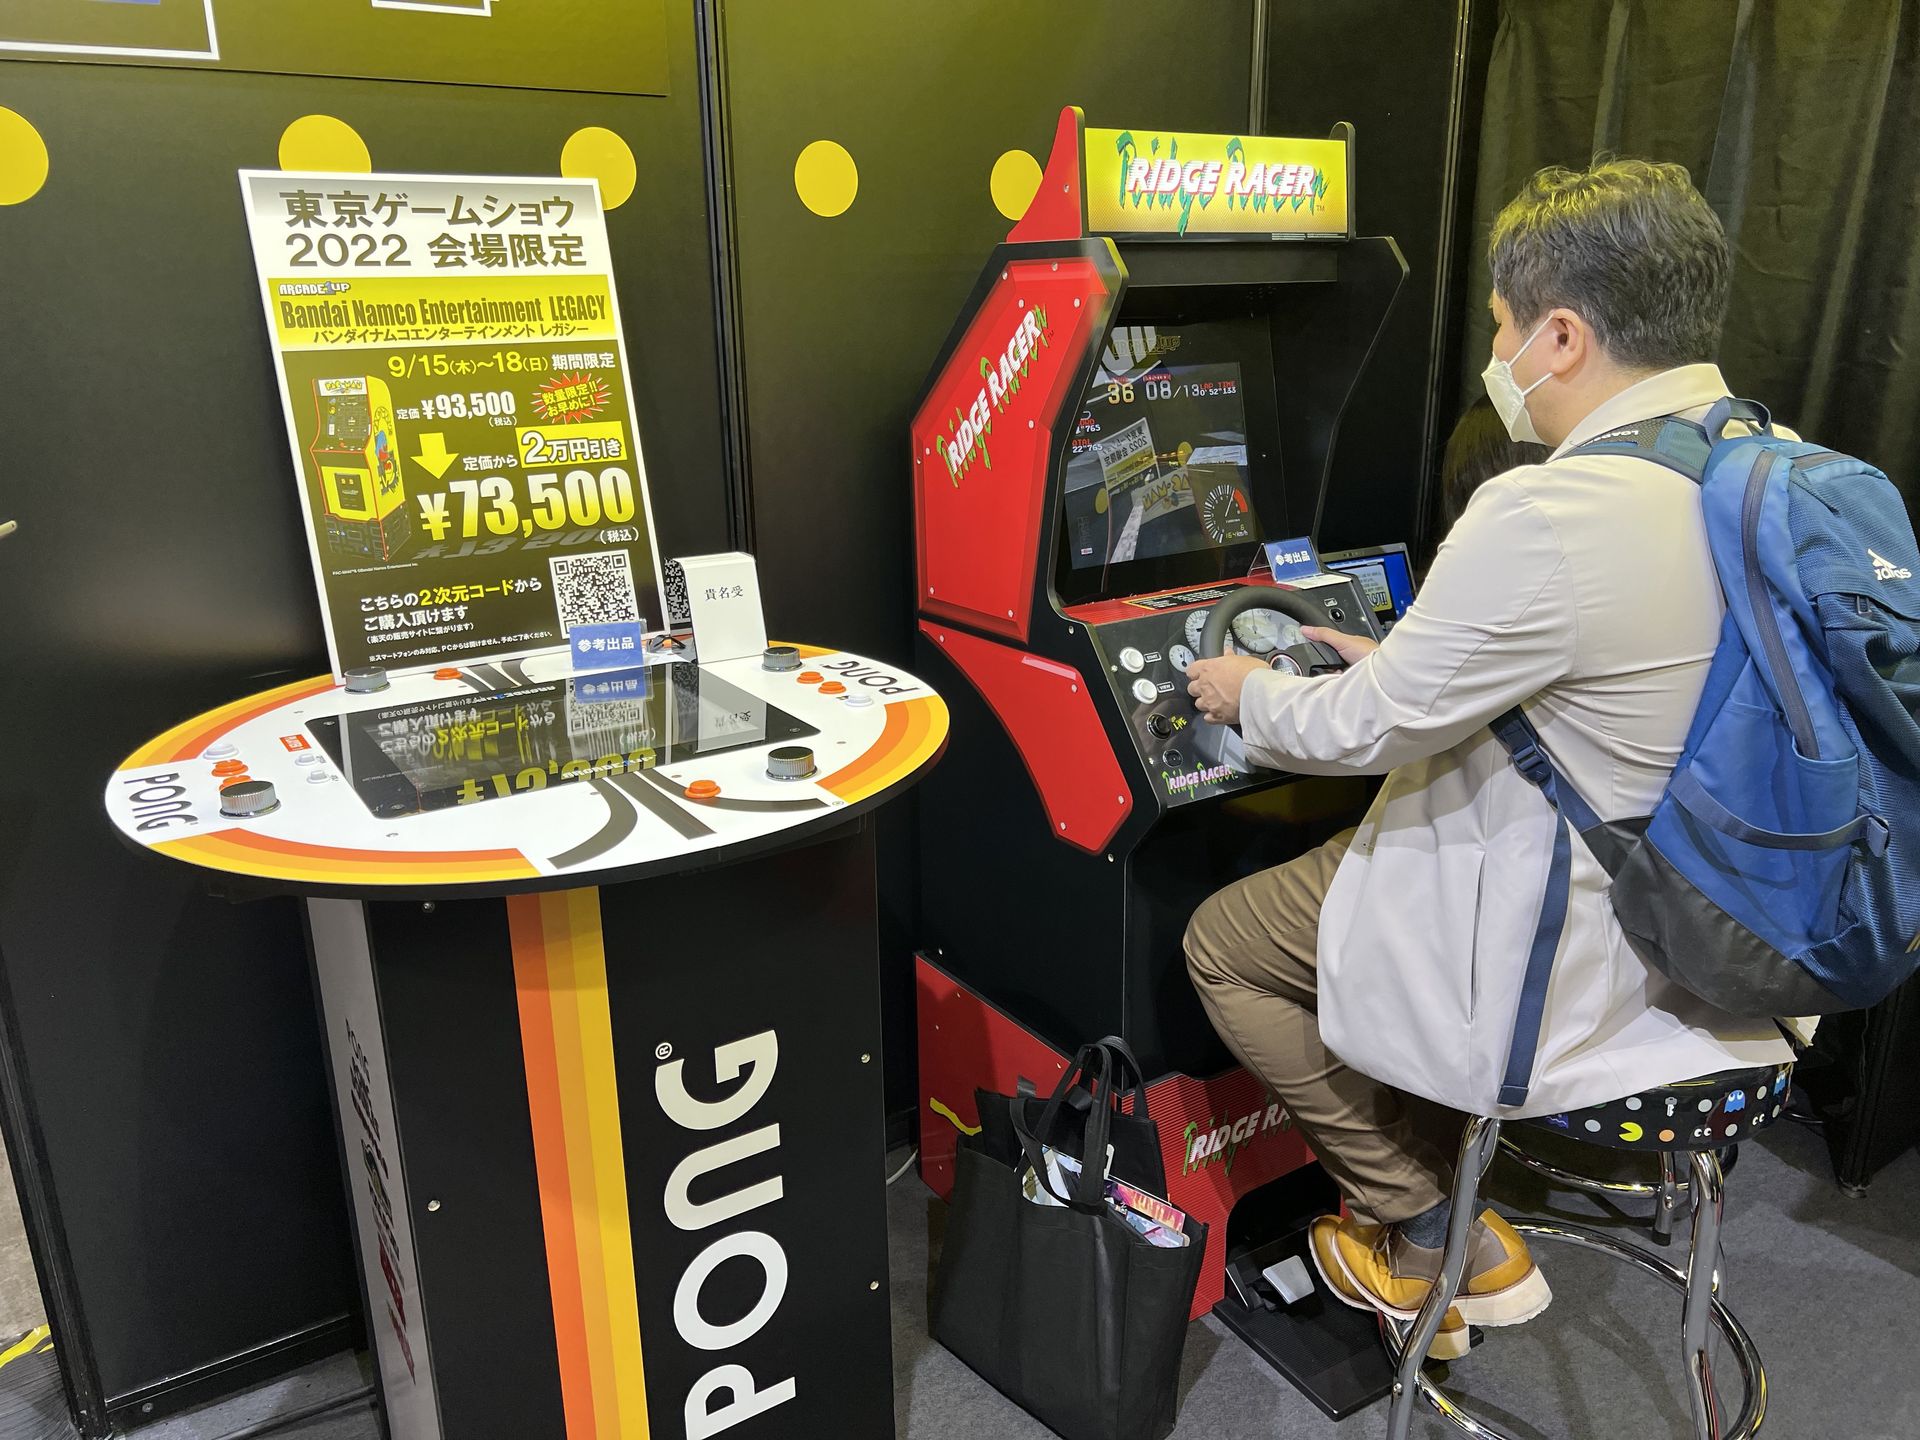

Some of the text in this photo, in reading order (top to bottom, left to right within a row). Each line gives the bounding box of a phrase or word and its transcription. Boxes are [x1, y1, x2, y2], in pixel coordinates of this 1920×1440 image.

[278, 189, 575, 229] 東京ゲームショウ
[285, 232, 587, 269] 2022 会場限定
[281, 295, 606, 329] Bandai Namco Entertainment LEGACY
[313, 323, 590, 345] バンダイナムコエンターテインメント レガシー
[552, 352, 615, 371] 期間限定
[396, 391, 516, 421] 定価 ¥93,500
[488, 416, 518, 427] (税込)
[463, 431, 622, 472] 定価から 2万円引き
[416, 467, 636, 542] ¥73,500
[599, 526, 640, 544] (税込)
[1275, 550, 1311, 566] 参考出品
[360, 577, 542, 612] こちらの2次元コードから
[705, 585, 744, 601] 貴名受
[364, 605, 469, 632] ご購入頂けます
[577, 636, 635, 653] 参考出品
[822, 660, 920, 695] PONG
[123, 772, 199, 832] PONG
[654, 1029, 797, 1440] PONG
